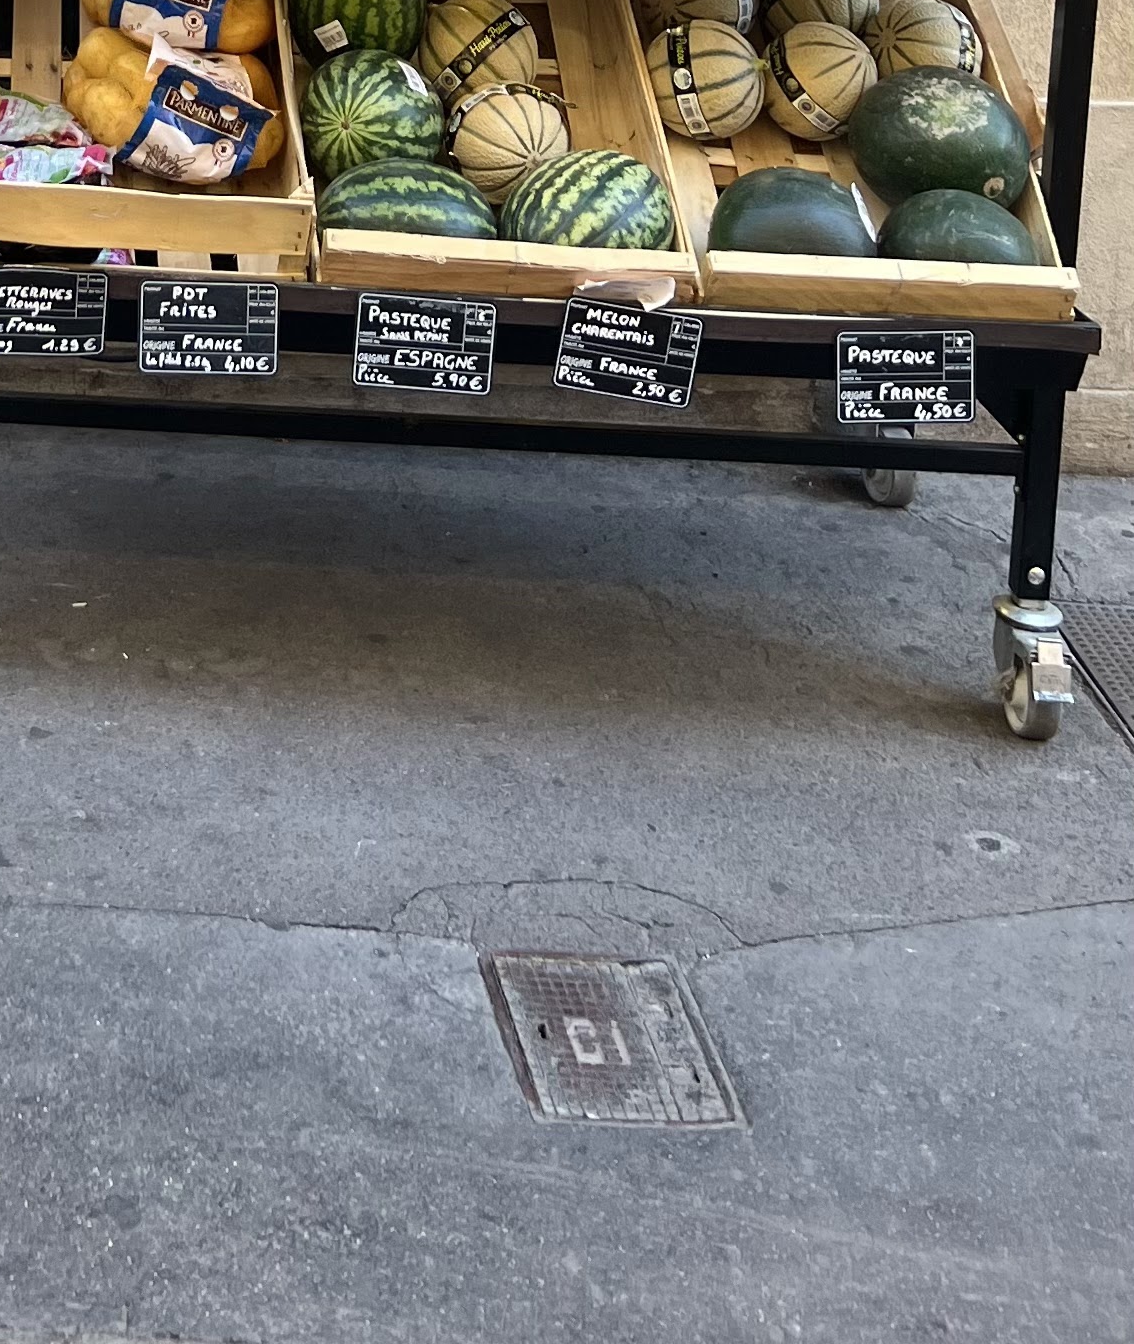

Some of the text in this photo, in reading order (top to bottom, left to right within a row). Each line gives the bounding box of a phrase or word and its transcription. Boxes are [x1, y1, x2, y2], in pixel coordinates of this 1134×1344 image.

[169, 90, 242, 133] PARMENTINE
[172, 286, 208, 300] PDT
[368, 305, 451, 330] PASTEQUE
[586, 308, 641, 327] MELON
[182, 334, 242, 352] FRANCE
[394, 349, 478, 371] ESPAGNE
[847, 346, 936, 365] PASTEQUE
[599, 357, 658, 380] FRANCE
[879, 382, 949, 401] FRANCE
